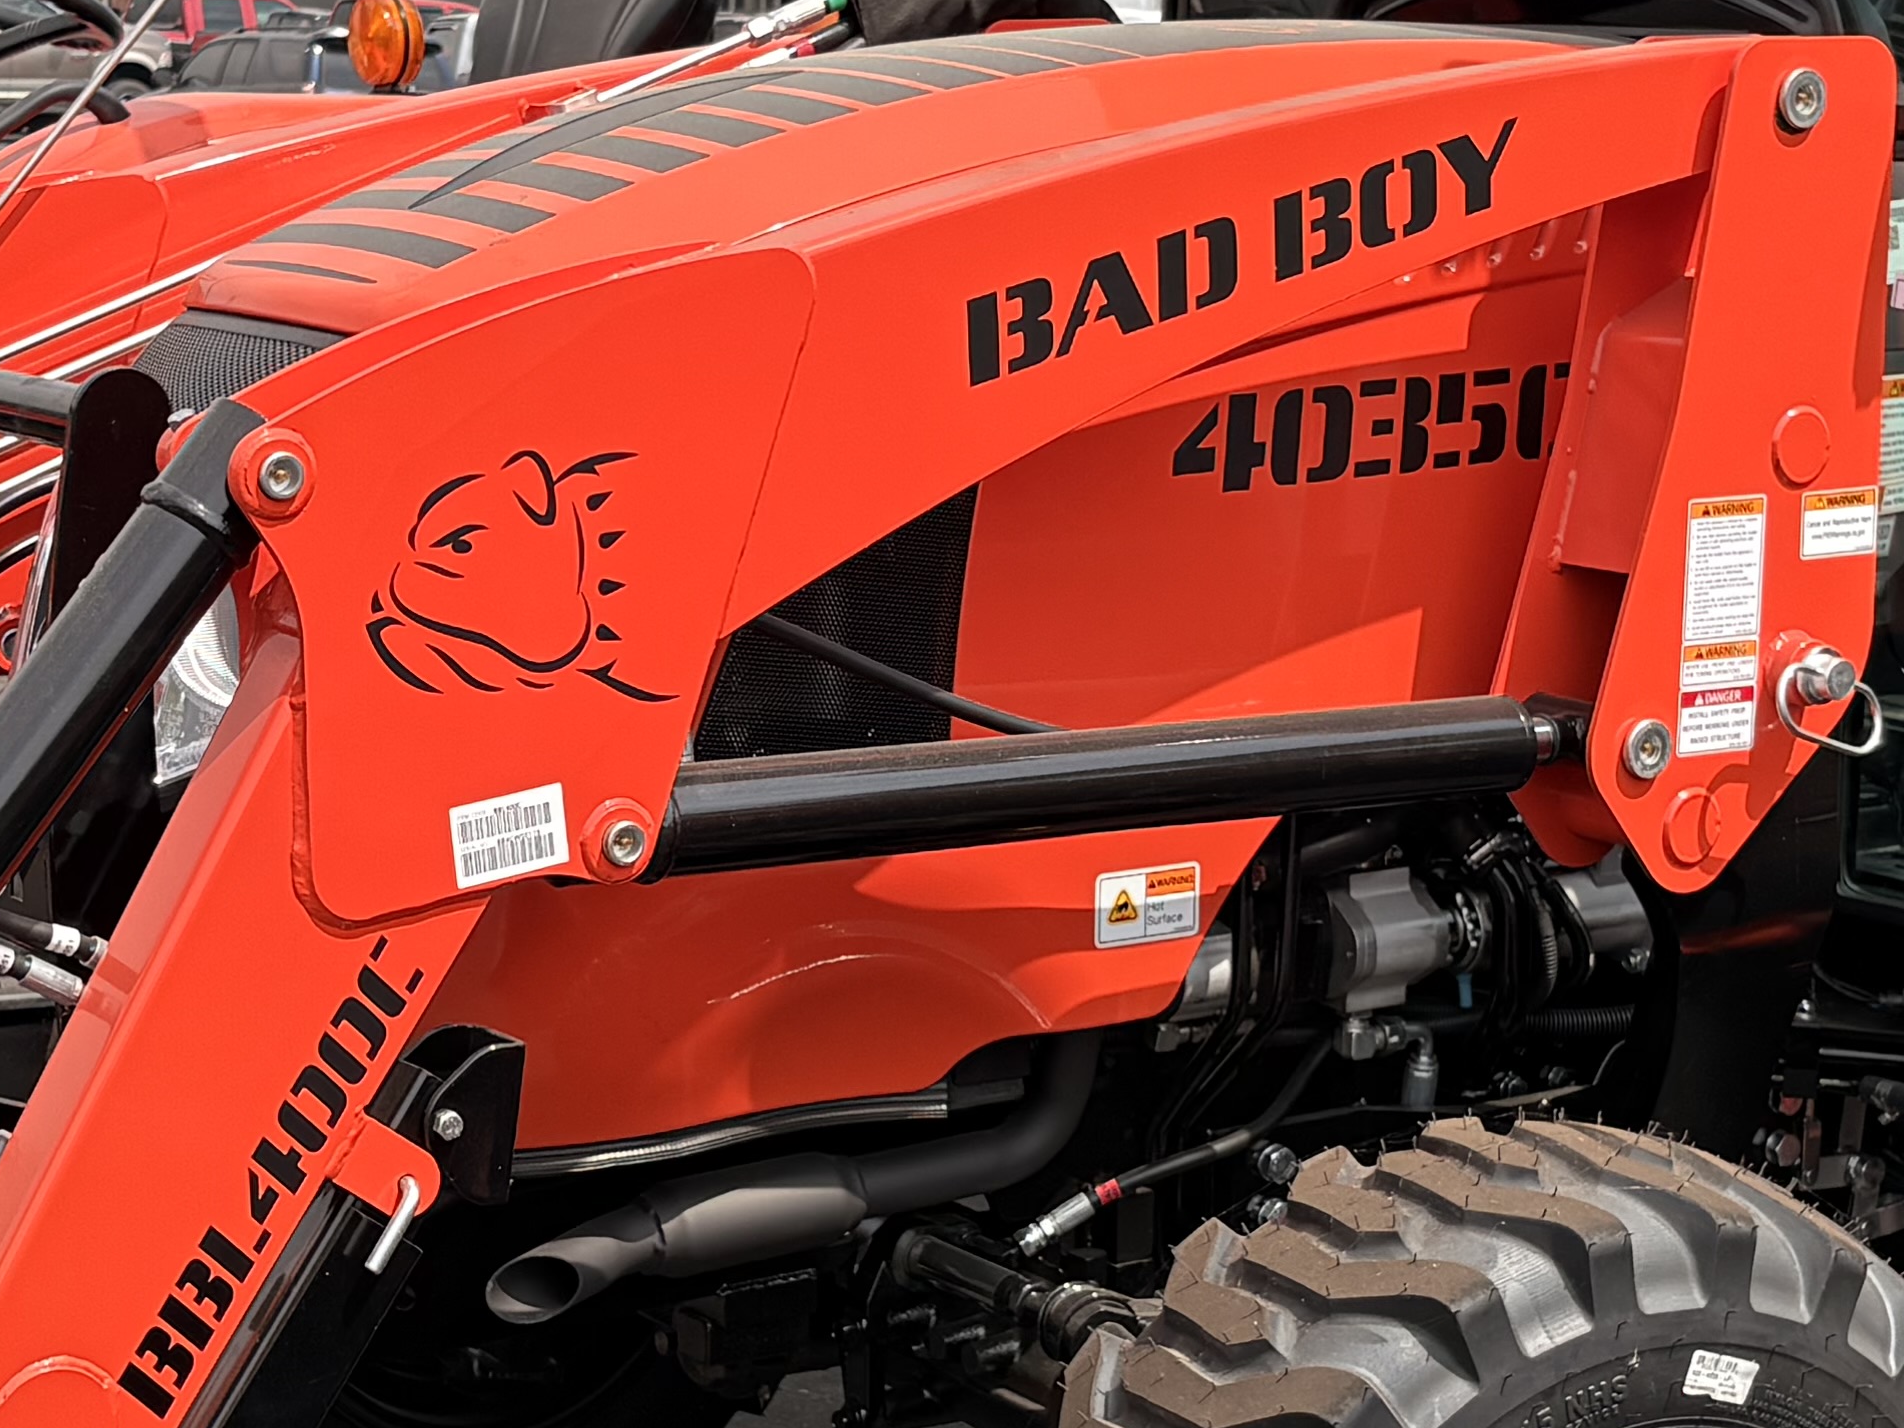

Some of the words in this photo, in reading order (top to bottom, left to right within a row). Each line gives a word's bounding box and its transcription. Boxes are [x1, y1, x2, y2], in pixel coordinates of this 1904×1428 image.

[965, 215, 1239, 389] BAD
[1273, 115, 1520, 283] BOY
[1826, 493, 1866, 508] WARNING
[1712, 501, 1755, 517] WARNING
[1705, 643, 1747, 658] WARNING
[1704, 689, 1742, 706] DANGER
[1156, 873, 1195, 887] WARNING
[1147, 900, 1165, 912] Hot
[1146, 912, 1183, 926] Surface
[1564, 1374, 1628, 1421] NHS
